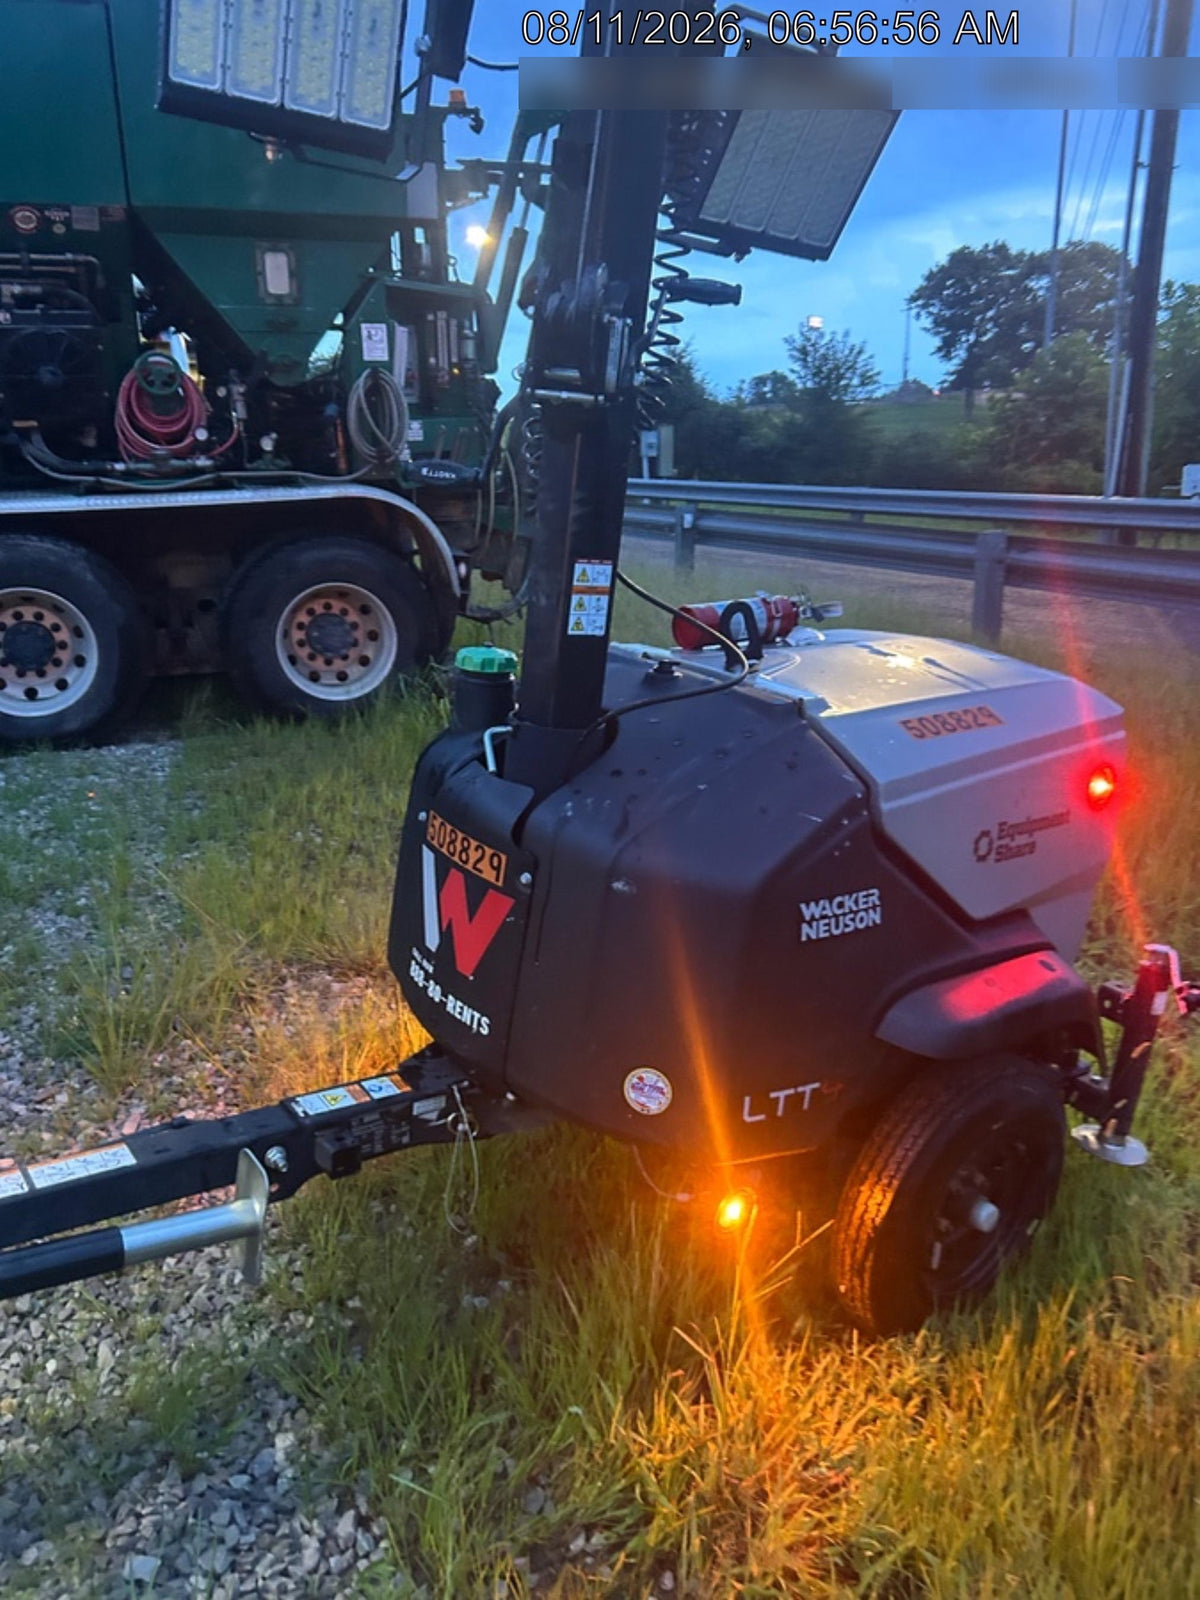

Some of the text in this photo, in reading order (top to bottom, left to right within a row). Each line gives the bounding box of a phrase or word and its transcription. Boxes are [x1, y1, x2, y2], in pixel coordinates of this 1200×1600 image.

[900, 706, 1003, 739] 508829
[997, 810, 1071, 841] Equipment
[428, 813, 502, 883] 508829
[800, 888, 880, 921] WACKER
[801, 906, 882, 942] NEUSON
